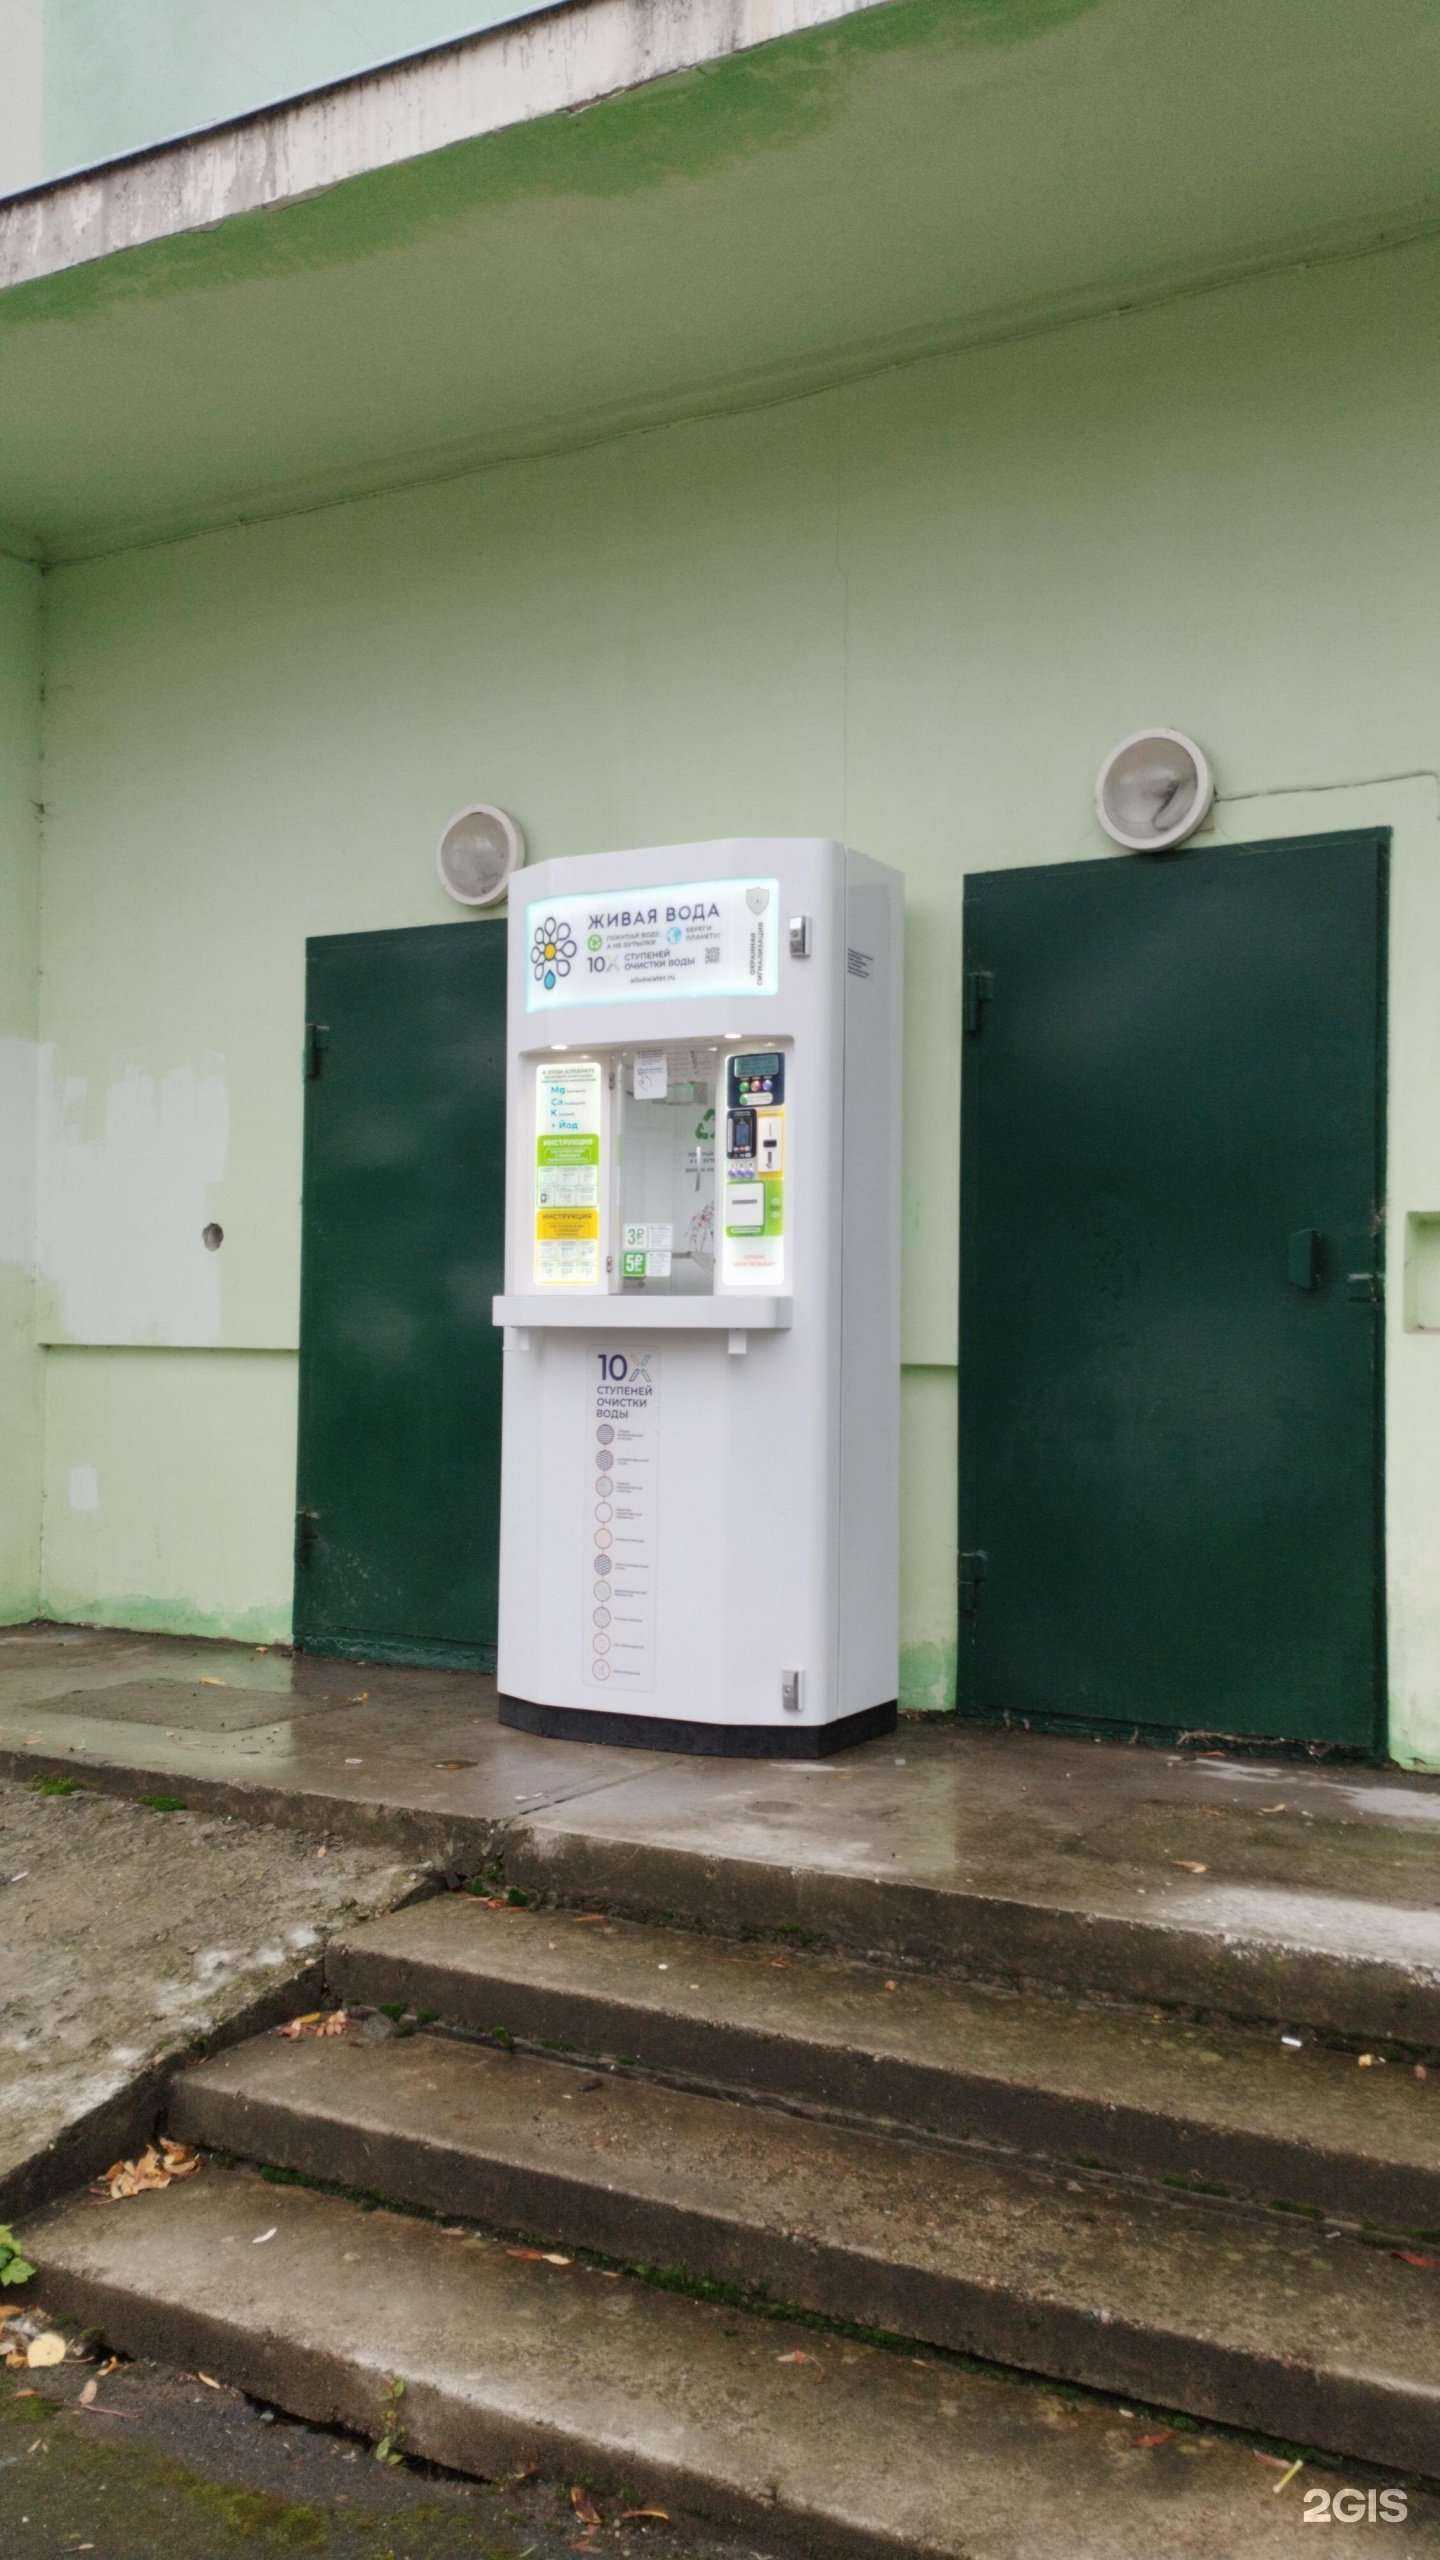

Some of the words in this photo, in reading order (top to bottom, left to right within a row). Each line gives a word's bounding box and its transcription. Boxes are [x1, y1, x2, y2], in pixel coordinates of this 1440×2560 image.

[588, 908, 657, 929] ЖИВАЯ
[666, 903, 720, 922] ВОДА
[624, 949, 671, 961] СТУПЕНЕЙ
[756, 921, 764, 986] СИГНАЛИЗАЦИЯ
[624, 960, 666, 970] ОЧИСТКИ
[668, 958, 696, 967] ВОДЫ
[551, 1087, 566, 1095] Mg
[597, 1385, 653, 1396] СТУПЕНЕЙ
[597, 1398, 648, 1408] ОЧИСТКИ
[596, 1409, 629, 1420] ВОДЫ
